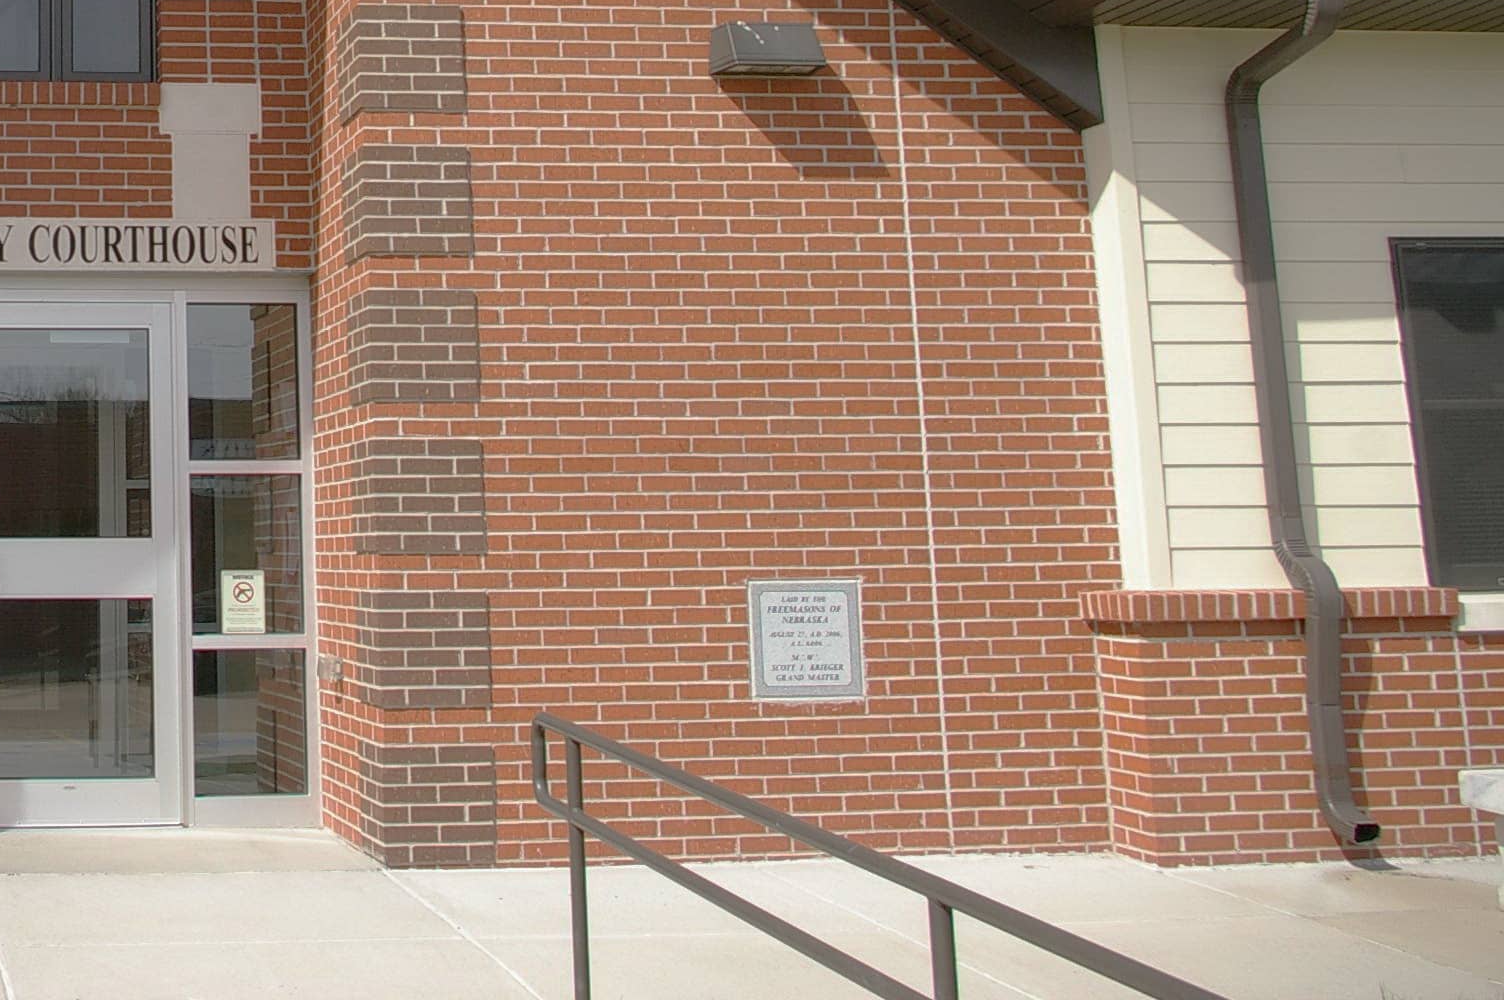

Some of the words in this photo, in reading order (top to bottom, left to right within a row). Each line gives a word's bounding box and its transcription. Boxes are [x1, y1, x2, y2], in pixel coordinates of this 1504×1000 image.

[28, 224, 260, 265] COURTHOUSE
[830, 605, 841, 613] OF
[782, 616, 829, 624] NEBRASKA
[776, 674, 805, 682] GRAND
